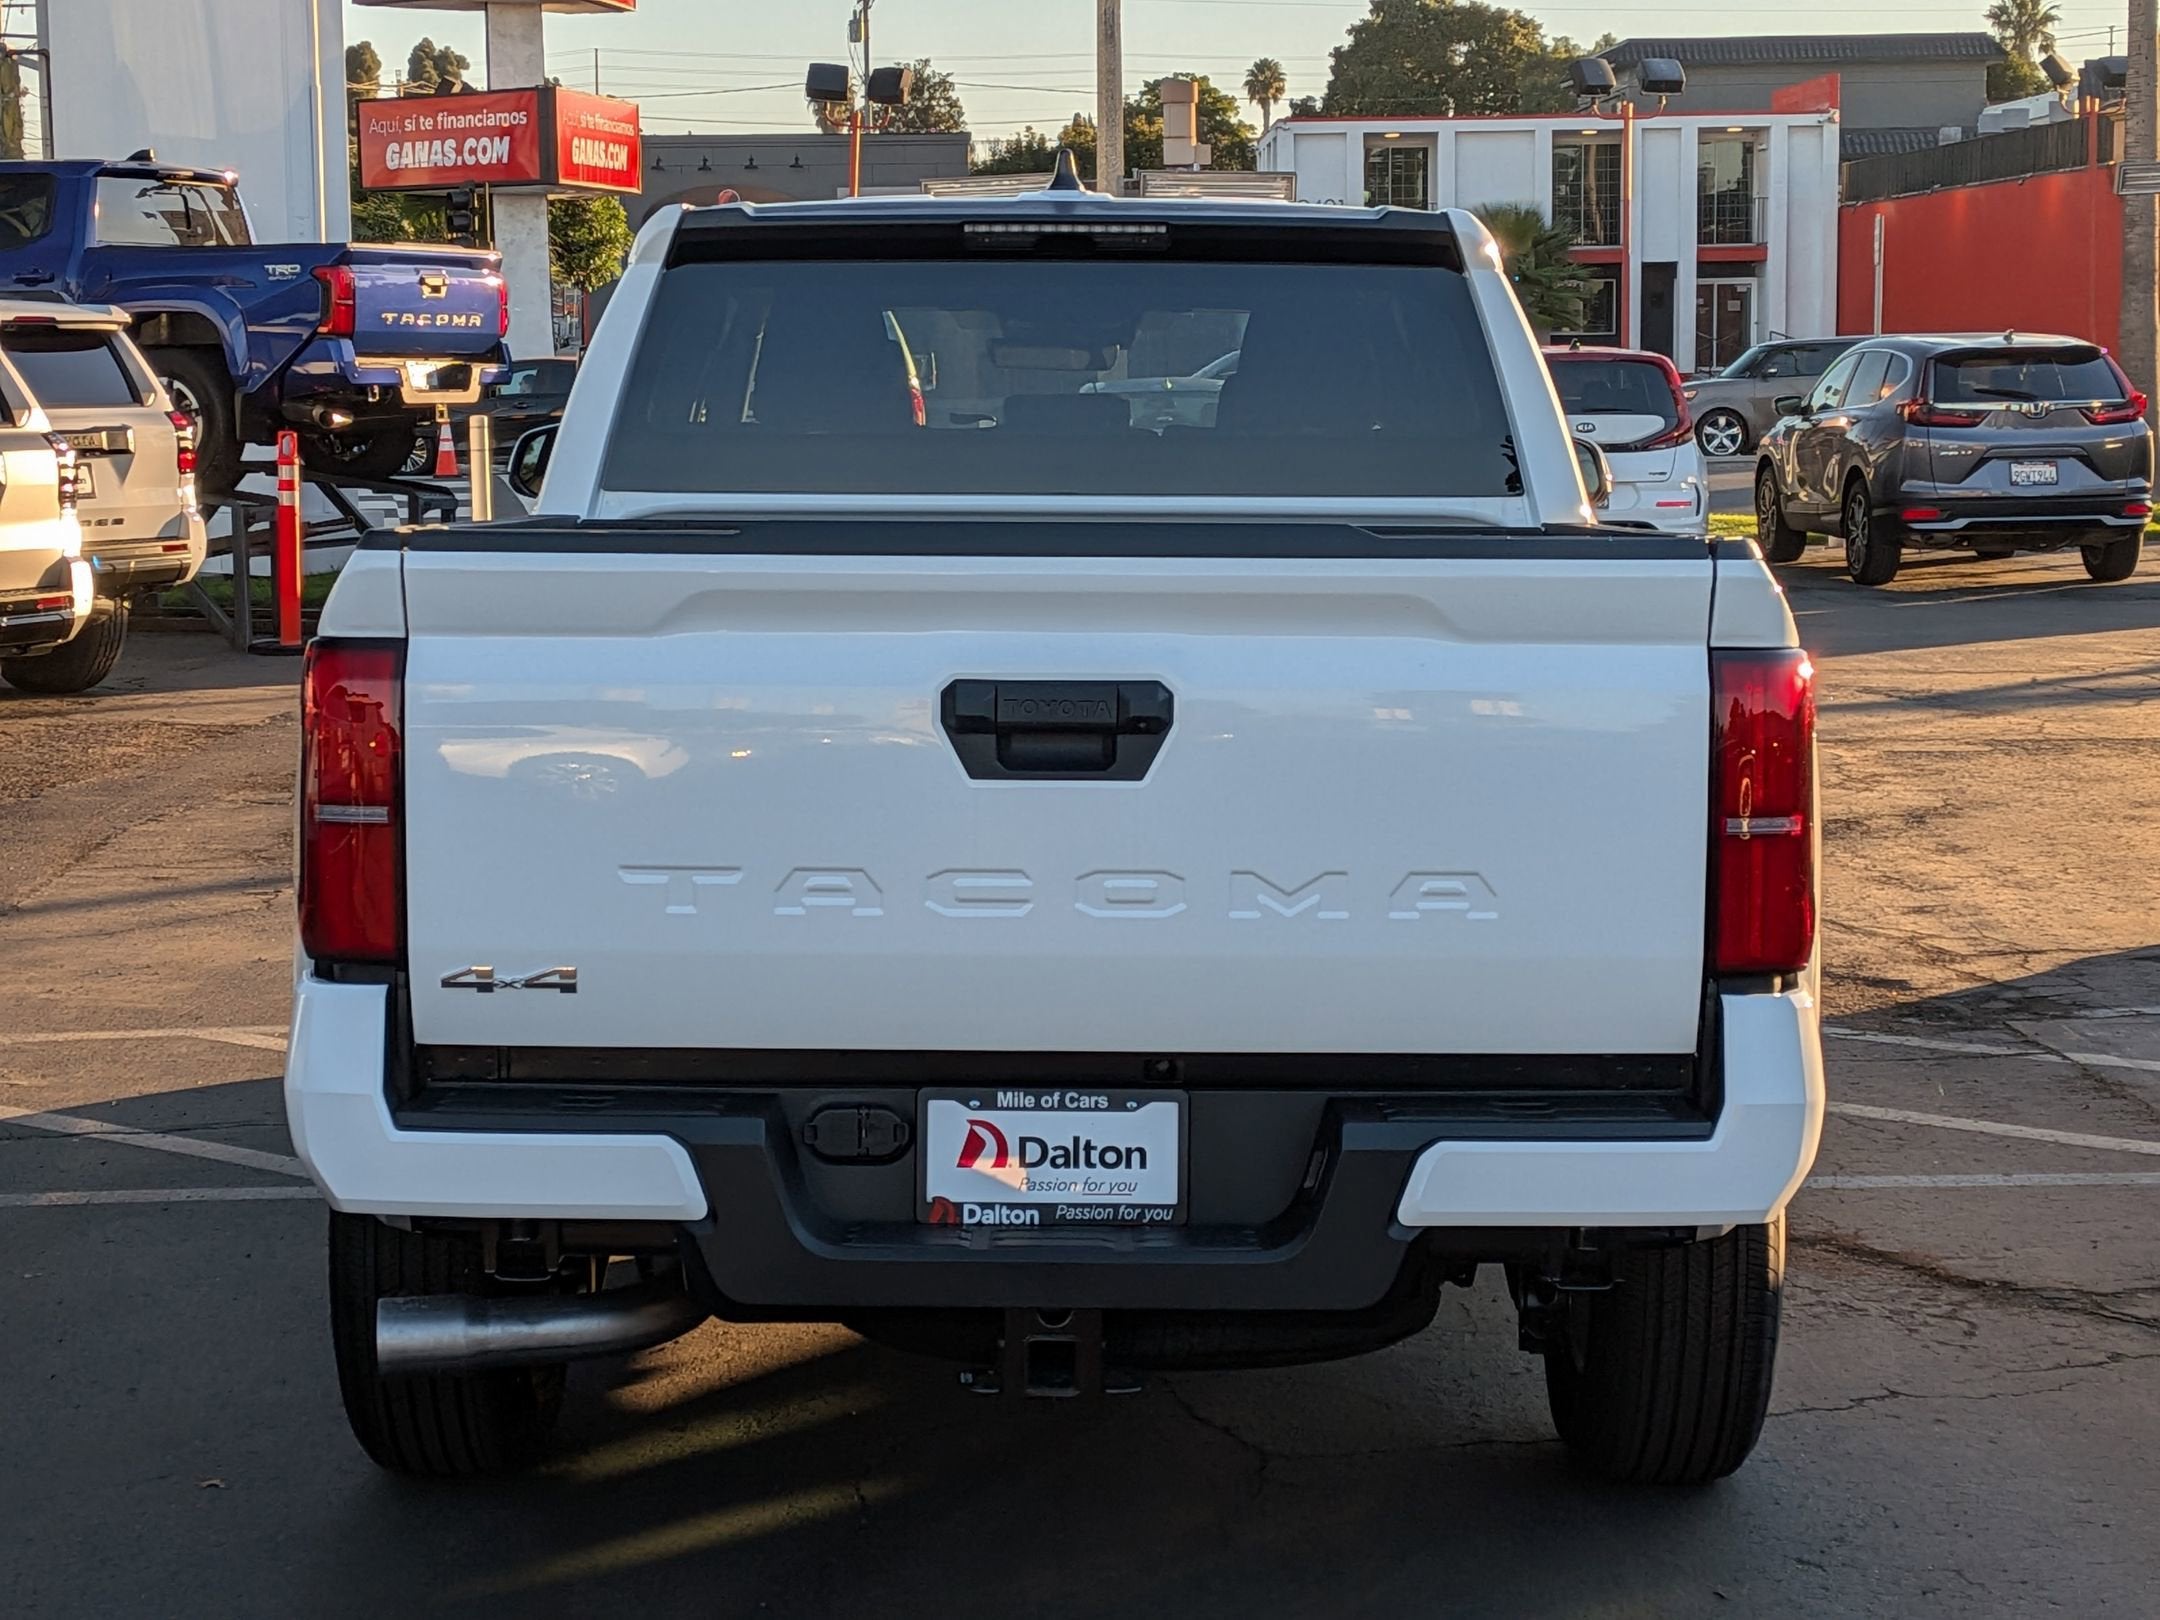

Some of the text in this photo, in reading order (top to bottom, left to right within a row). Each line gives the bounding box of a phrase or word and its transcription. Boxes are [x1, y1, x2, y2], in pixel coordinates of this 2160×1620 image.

[369, 109, 527, 136] Aquí, sí te financiamos
[386, 136, 510, 170] GANAS.COM
[572, 136, 628, 172] GANAS.COM
[264, 264, 301, 275] TRD
[381, 312, 482, 327] TACOMA
[1003, 699, 1112, 719] TOYOTA
[618, 864, 1499, 920] TACOMA
[997, 1091, 1109, 1109] Mile of Cars
[1018, 1136, 1147, 1170] Dalton
[1018, 1177, 1138, 1195] Passion for you
[963, 1204, 1040, 1225] Dalton
[1056, 1204, 1174, 1223] Passion for you
